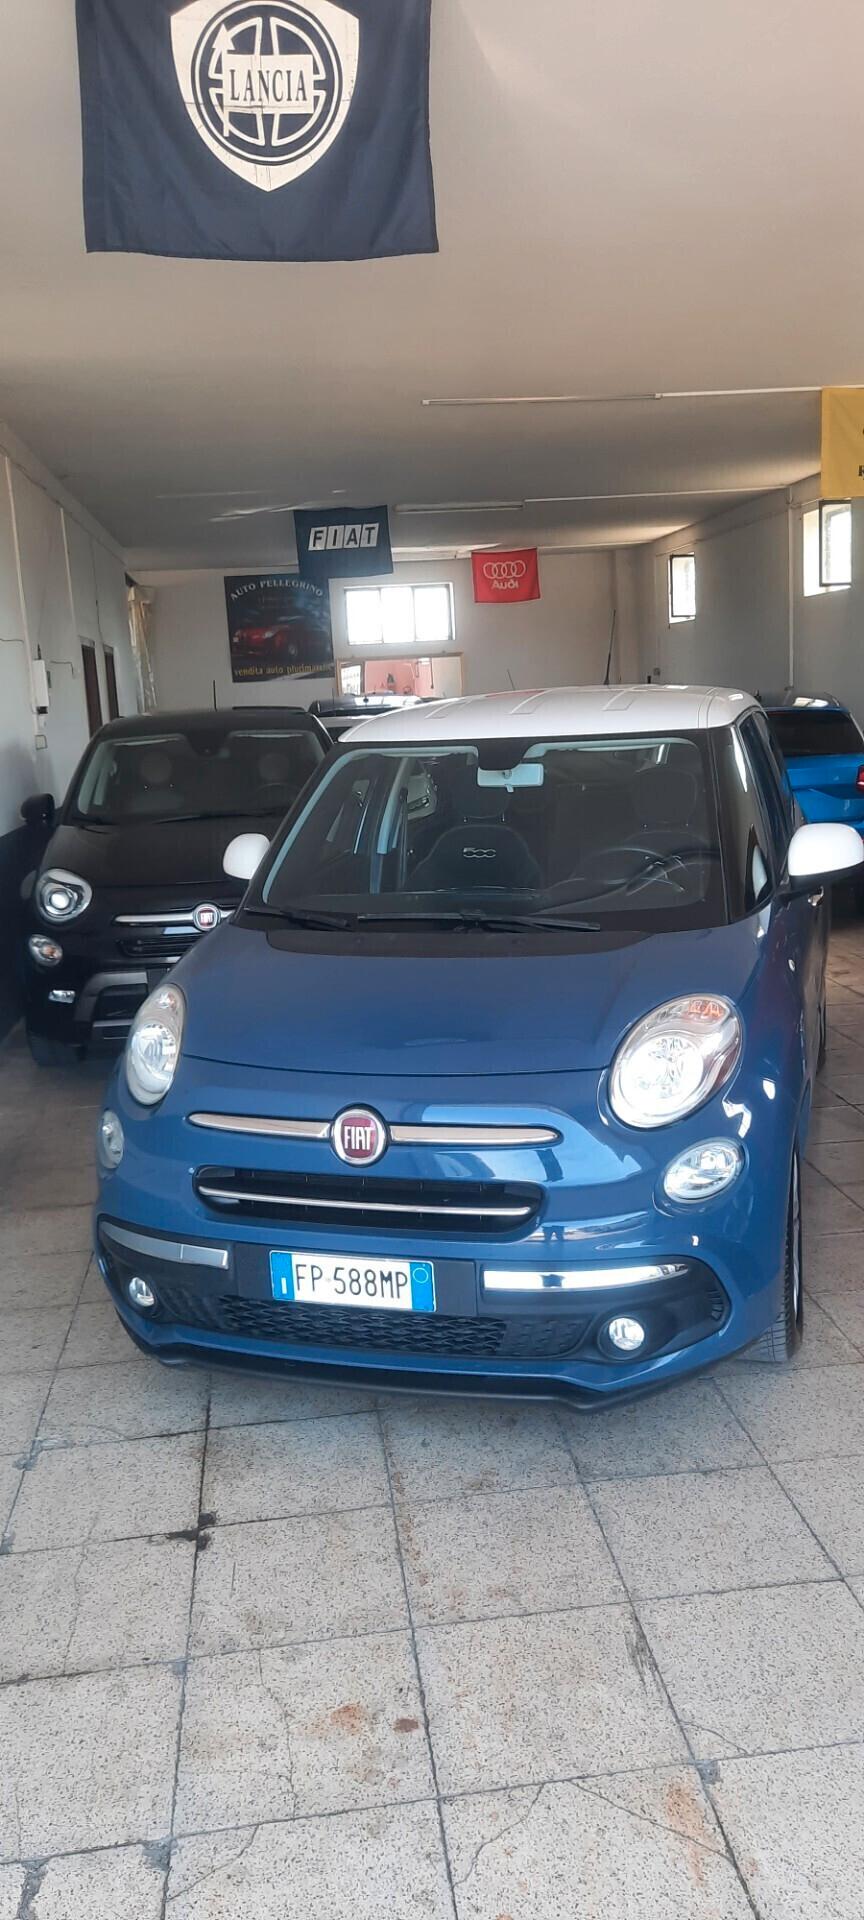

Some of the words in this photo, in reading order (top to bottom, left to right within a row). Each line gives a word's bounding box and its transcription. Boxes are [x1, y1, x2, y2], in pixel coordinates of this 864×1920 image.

[229, 69, 308, 102] LANCIA
[311, 525, 377, 548] FIAT
[230, 583, 256, 600] AUTO
[260, 579, 323, 597] PELLEGRINO
[490, 579, 519, 590] Audi
[344, 1125, 376, 1150] FIAT
[295, 1263, 323, 1292] FP
[333, 1267, 408, 1299] 588MP
